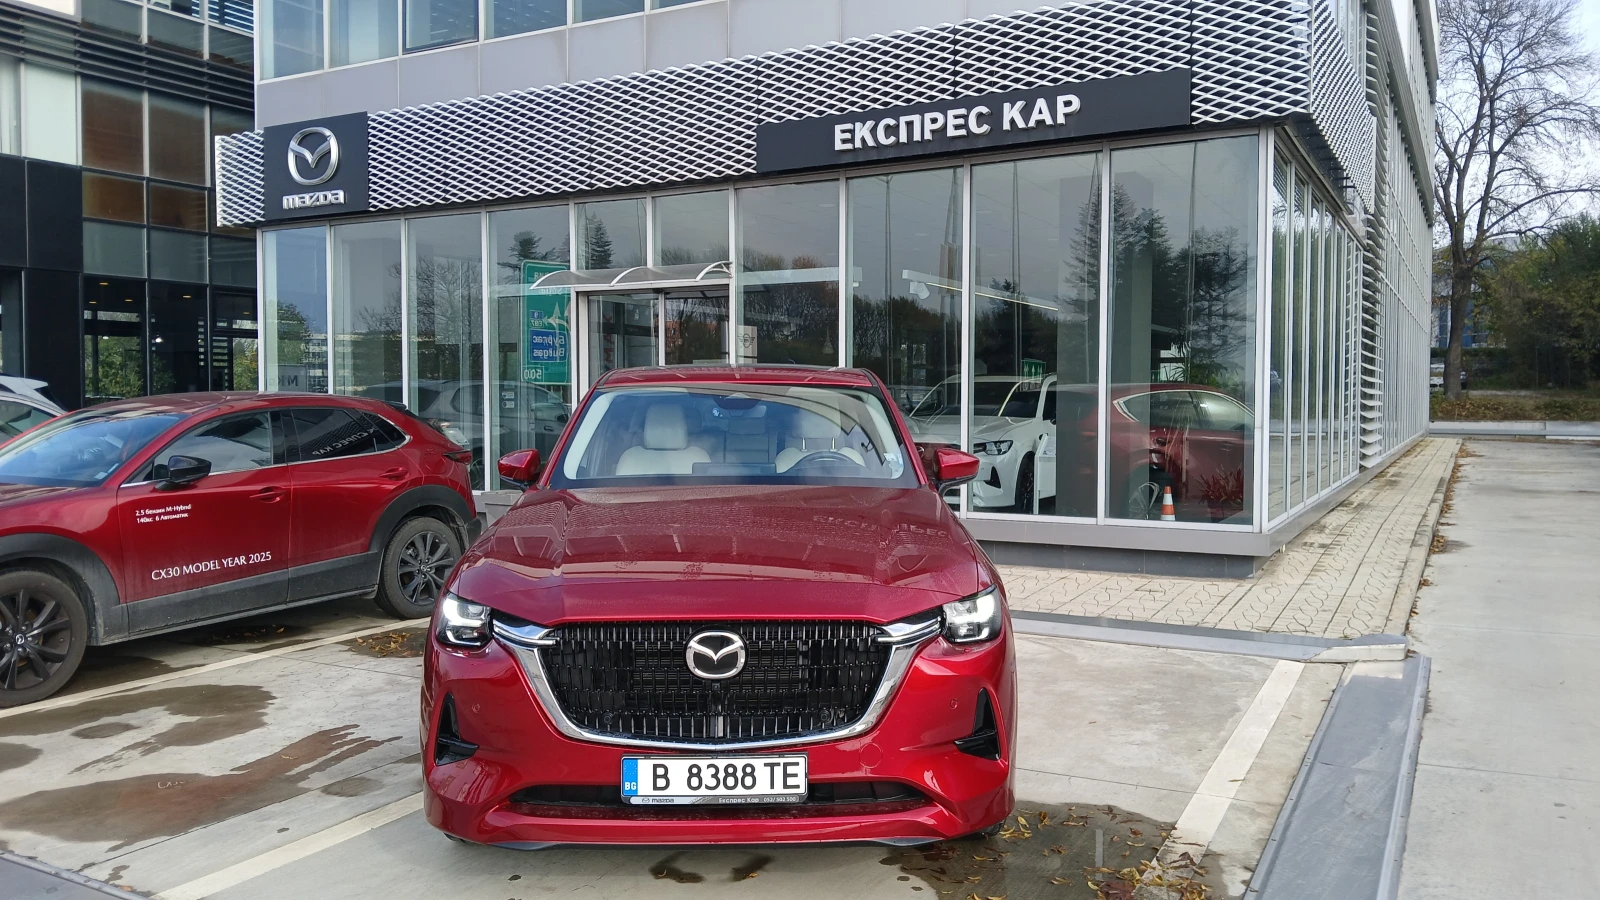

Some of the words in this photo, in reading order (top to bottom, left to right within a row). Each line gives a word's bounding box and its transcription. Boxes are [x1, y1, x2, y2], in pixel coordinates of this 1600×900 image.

[834, 105, 992, 151] ЕКСПРЕС
[1002, 94, 1081, 131] КАР
[282, 189, 345, 210] mazda
[151, 567, 180, 580] CX30
[182, 560, 221, 575] MODEL
[221, 555, 248, 569] YEAR
[248, 551, 272, 565] 2025
[624, 781, 637, 791] BG
[652, 763, 671, 791] B
[686, 763, 757, 791] 8388
[763, 762, 801, 790] TE
